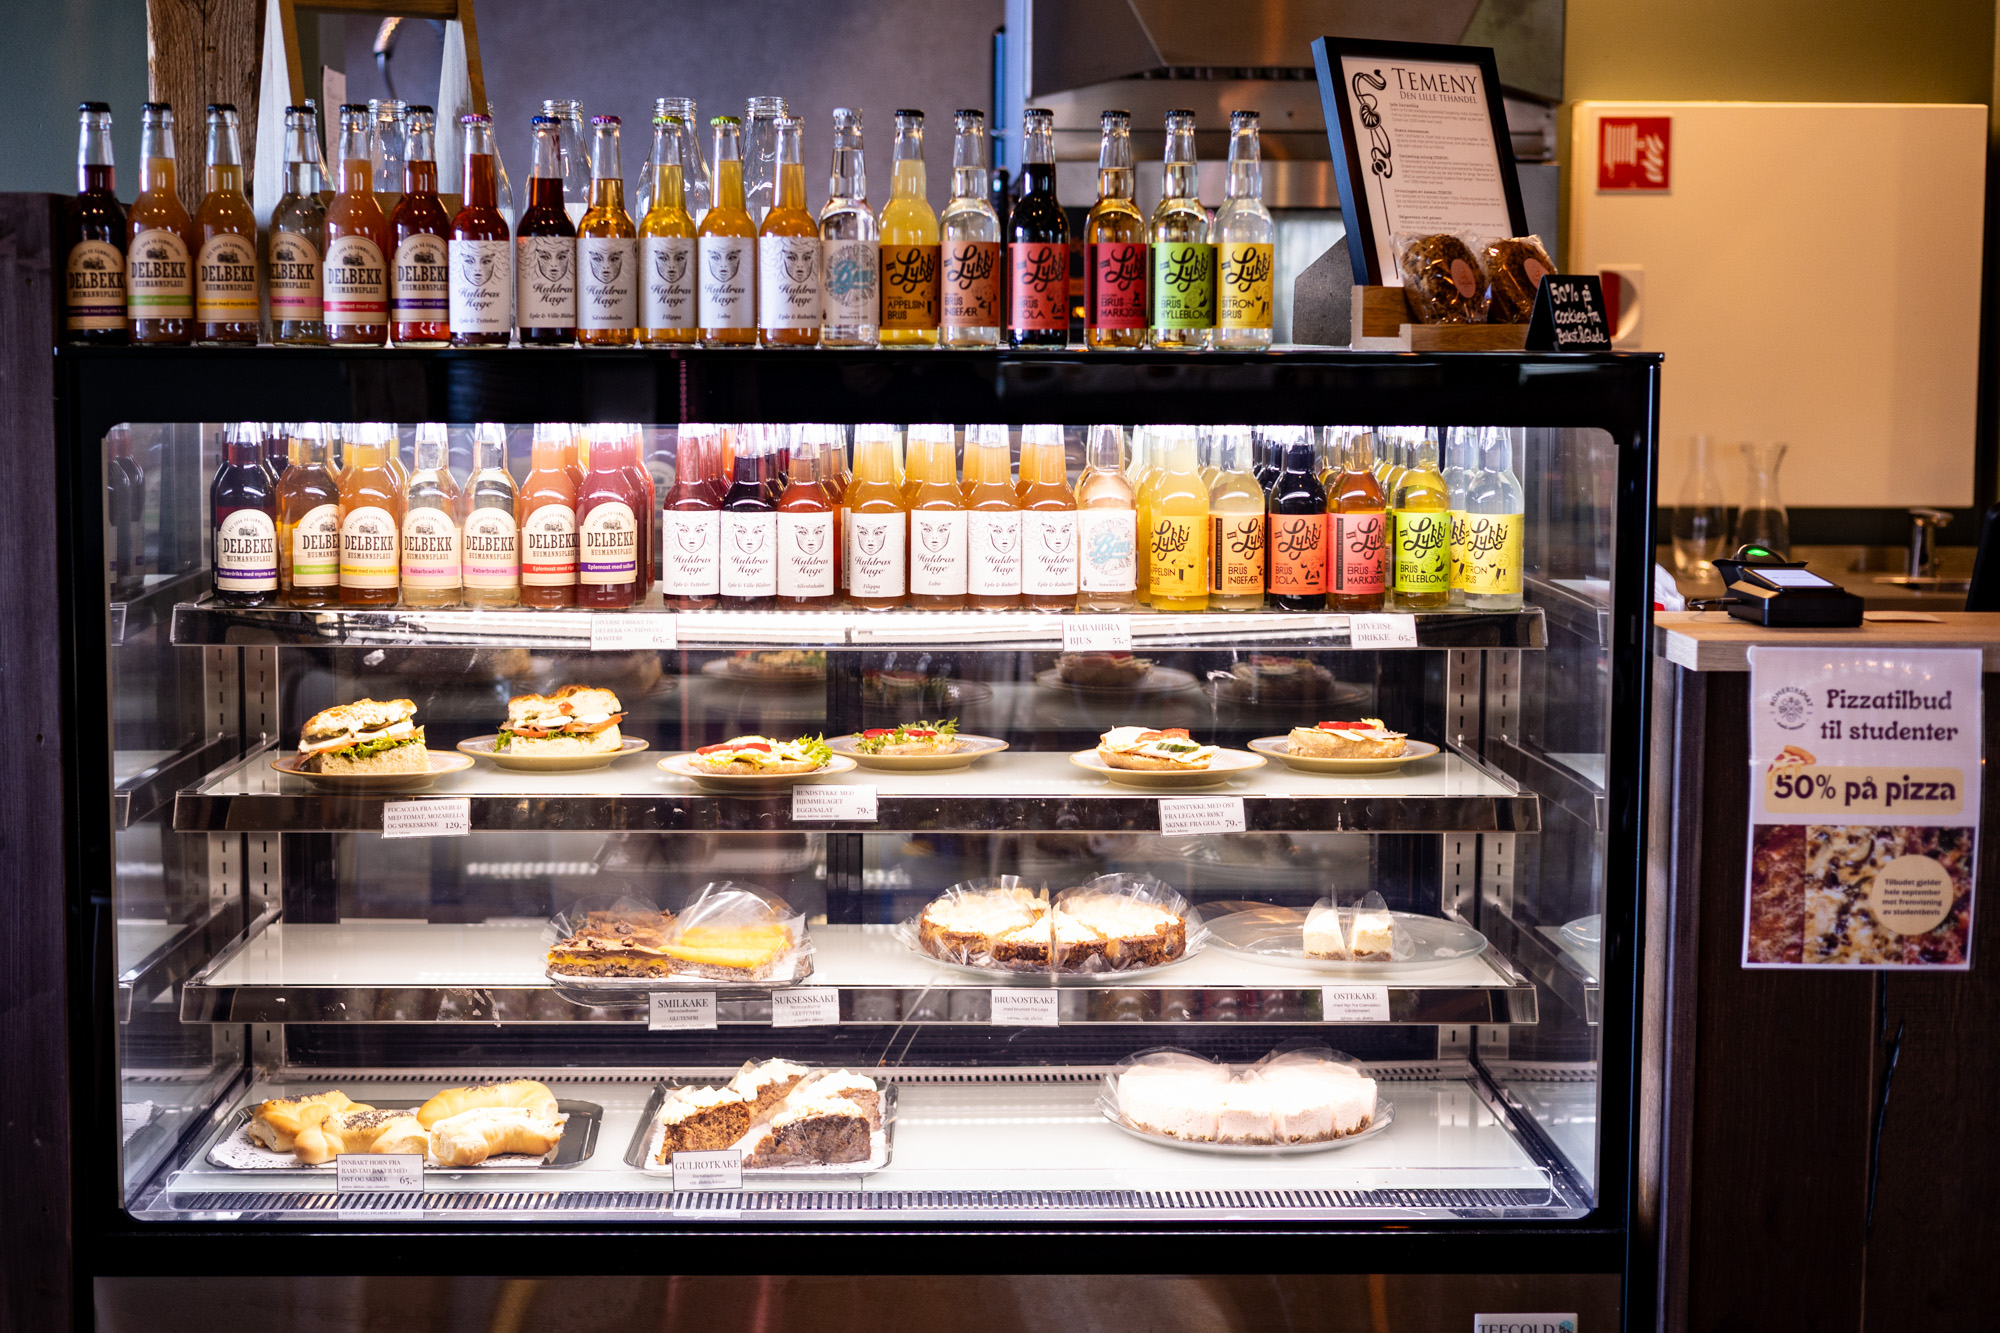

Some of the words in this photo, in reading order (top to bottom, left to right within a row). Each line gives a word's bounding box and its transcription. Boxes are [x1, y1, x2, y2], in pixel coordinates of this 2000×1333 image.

[1391, 68, 1477, 94] TEMENY
[1400, 91, 1416, 100] DEN
[1419, 93, 1438, 101] LILLE
[1439, 95, 1478, 104] TEHANDEL
[132, 262, 186, 278] DELBEKK
[890, 248, 936, 294] Lykki
[947, 245, 994, 290] Lykki
[1164, 247, 1208, 292] Lykki
[1225, 247, 1270, 292] Lykki
[202, 265, 255, 282] DELBEKK
[328, 268, 382, 285] DELBEKK
[69, 272, 124, 288] DELBEKK
[458, 288, 500, 298] Huldras
[533, 283, 573, 294] Huldras
[586, 286, 628, 296] Huldras
[651, 285, 692, 296] Huldras
[705, 284, 745, 294] Huldras
[779, 284, 816, 294] Huldras
[540, 294, 568, 306] Hage
[711, 295, 740, 306] Hage
[787, 294, 812, 307] Hage
[1550, 283, 1579, 304] 50%
[1582, 284, 1592, 308] på
[465, 298, 494, 311] Hage
[593, 296, 622, 308] Hage
[658, 296, 686, 308] Hage
[1102, 298, 1124, 308] BRUS
[1161, 300, 1182, 308] BRUS
[1222, 300, 1254, 308] SITRON
[888, 311, 907, 320] BRUS
[1222, 310, 1242, 318] BRUS
[1554, 307, 1588, 324] cookies
[345, 535, 394, 550] DELBEKK
[529, 533, 577, 548] DELBEKK
[588, 531, 634, 546] DELBEKK
[1152, 520, 1190, 562] Lykki
[1278, 518, 1322, 560] Lykki
[1403, 517, 1446, 558] Lykki
[1467, 518, 1508, 560] Lykki
[224, 538, 273, 554] DELBEKK
[404, 536, 452, 552] DELBEKK
[466, 536, 514, 552] DELBEKK
[1090, 532, 1130, 564] Bjus
[673, 554, 711, 564] Huldras
[731, 556, 768, 565] Huldras
[792, 556, 828, 566] Huldras
[854, 556, 891, 566] Huldras
[918, 554, 955, 564] Huldras
[1038, 555, 1074, 564] Huldras
[679, 564, 706, 576] Hage
[737, 566, 763, 576] Hage
[798, 566, 824, 577] Hage
[860, 566, 885, 578] Hage
[922, 564, 949, 574] Hage
[1046, 565, 1070, 576] Hage
[1228, 566, 1248, 575] BRUS
[1276, 566, 1292, 575] BRUS
[1348, 566, 1368, 574] BRUS
[1400, 564, 1418, 573] BRUS
[1228, 576, 1258, 584] INGEFÆR
[1070, 637, 1092, 646] BJUS
[1827, 689, 1952, 710] Pizzatilbud
[1820, 720, 1842, 740] til
[1850, 720, 1958, 740] studenter
[1774, 774, 1836, 800] 50%
[1844, 776, 1878, 806] på
[1885, 774, 1956, 807] pizza
[1916, 879, 1942, 887] gjelder
[658, 998, 708, 1008] SMILKAKE
[774, 994, 836, 1004] SUKSESSKAKE
[994, 996, 1056, 1004] BRUNOSTKAKE
[675, 1160, 740, 1170] GULROTKAKE
